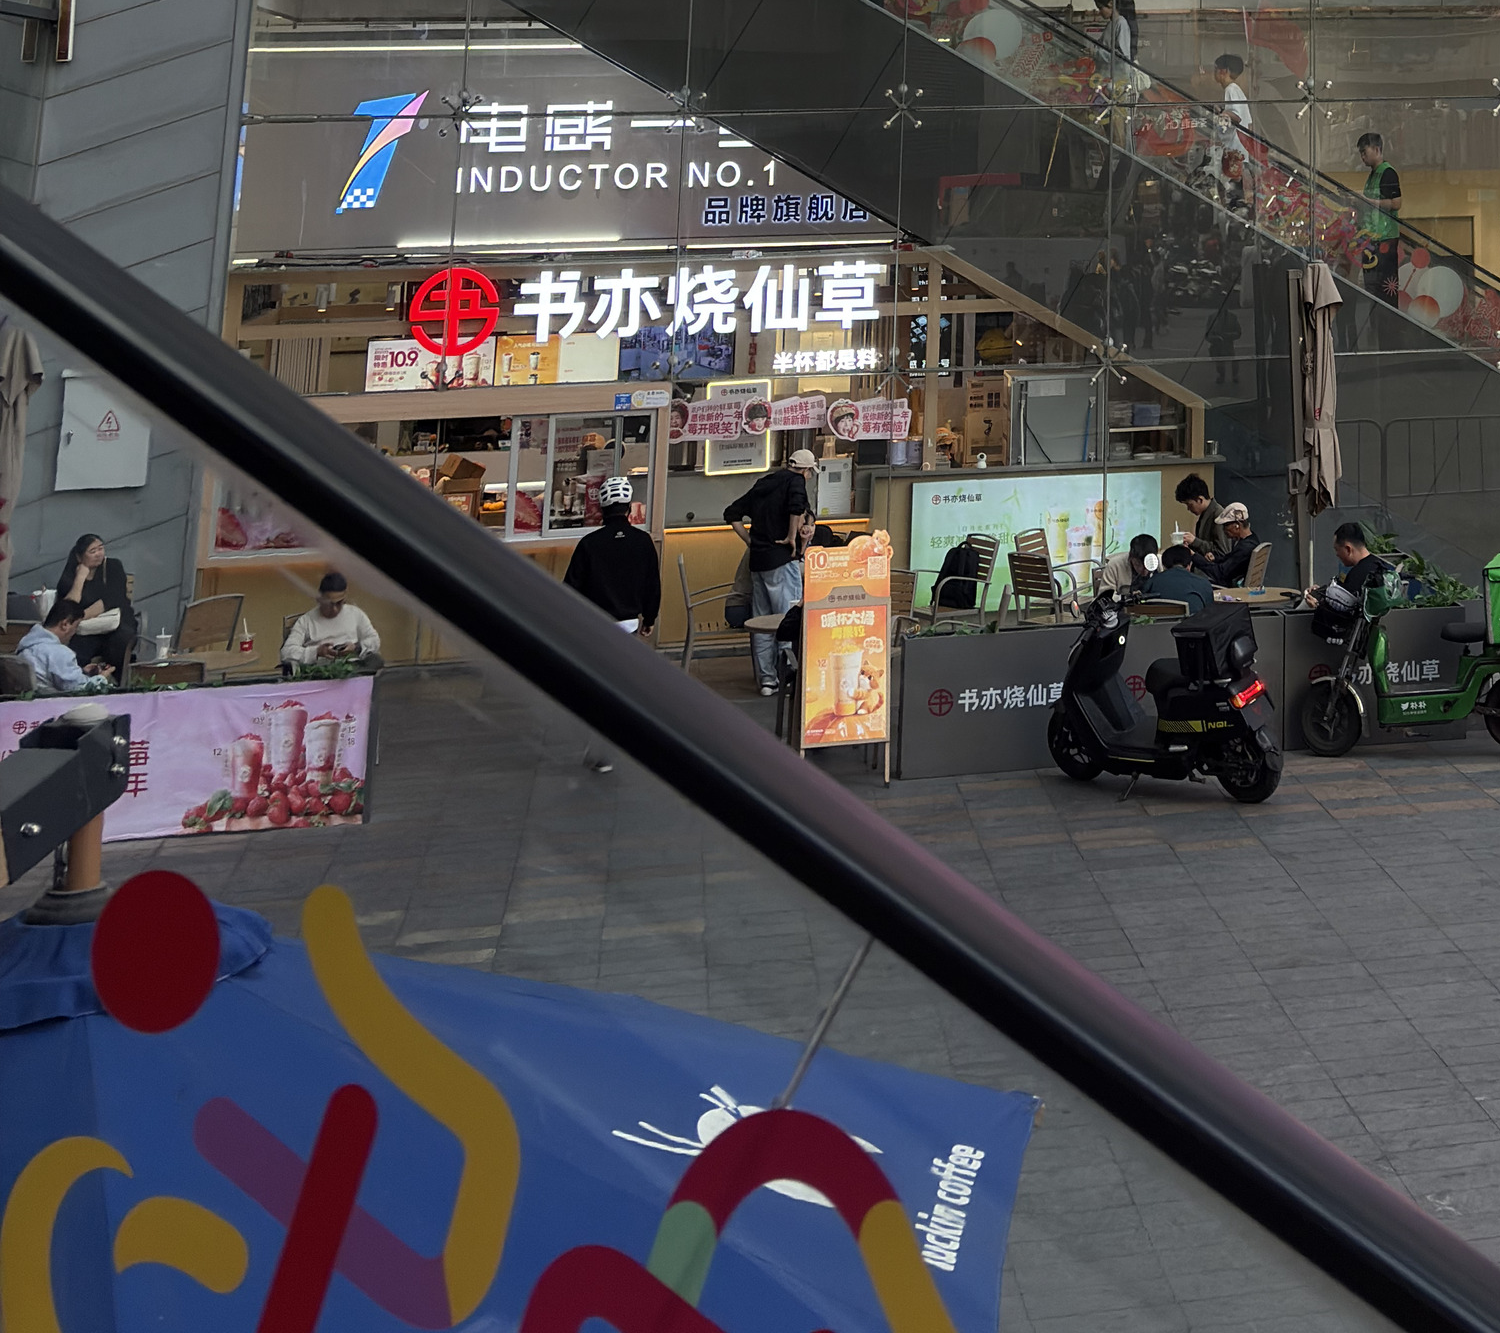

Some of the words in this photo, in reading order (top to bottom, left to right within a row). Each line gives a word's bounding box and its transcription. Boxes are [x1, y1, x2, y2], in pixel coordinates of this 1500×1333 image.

[455, 163, 669, 194] INDUCTOR
[688, 161, 777, 189] NO.1
[703, 195, 869, 227] 品牌旗舰店
[512, 261, 883, 345] 书亦烧仙草
[388, 349, 419, 369] 10.9
[772, 347, 878, 374] 半杯都是料
[213, 748, 222, 757] 12
[930, 1144, 985, 1206] coffee
[914, 1203, 967, 1272] luckin
